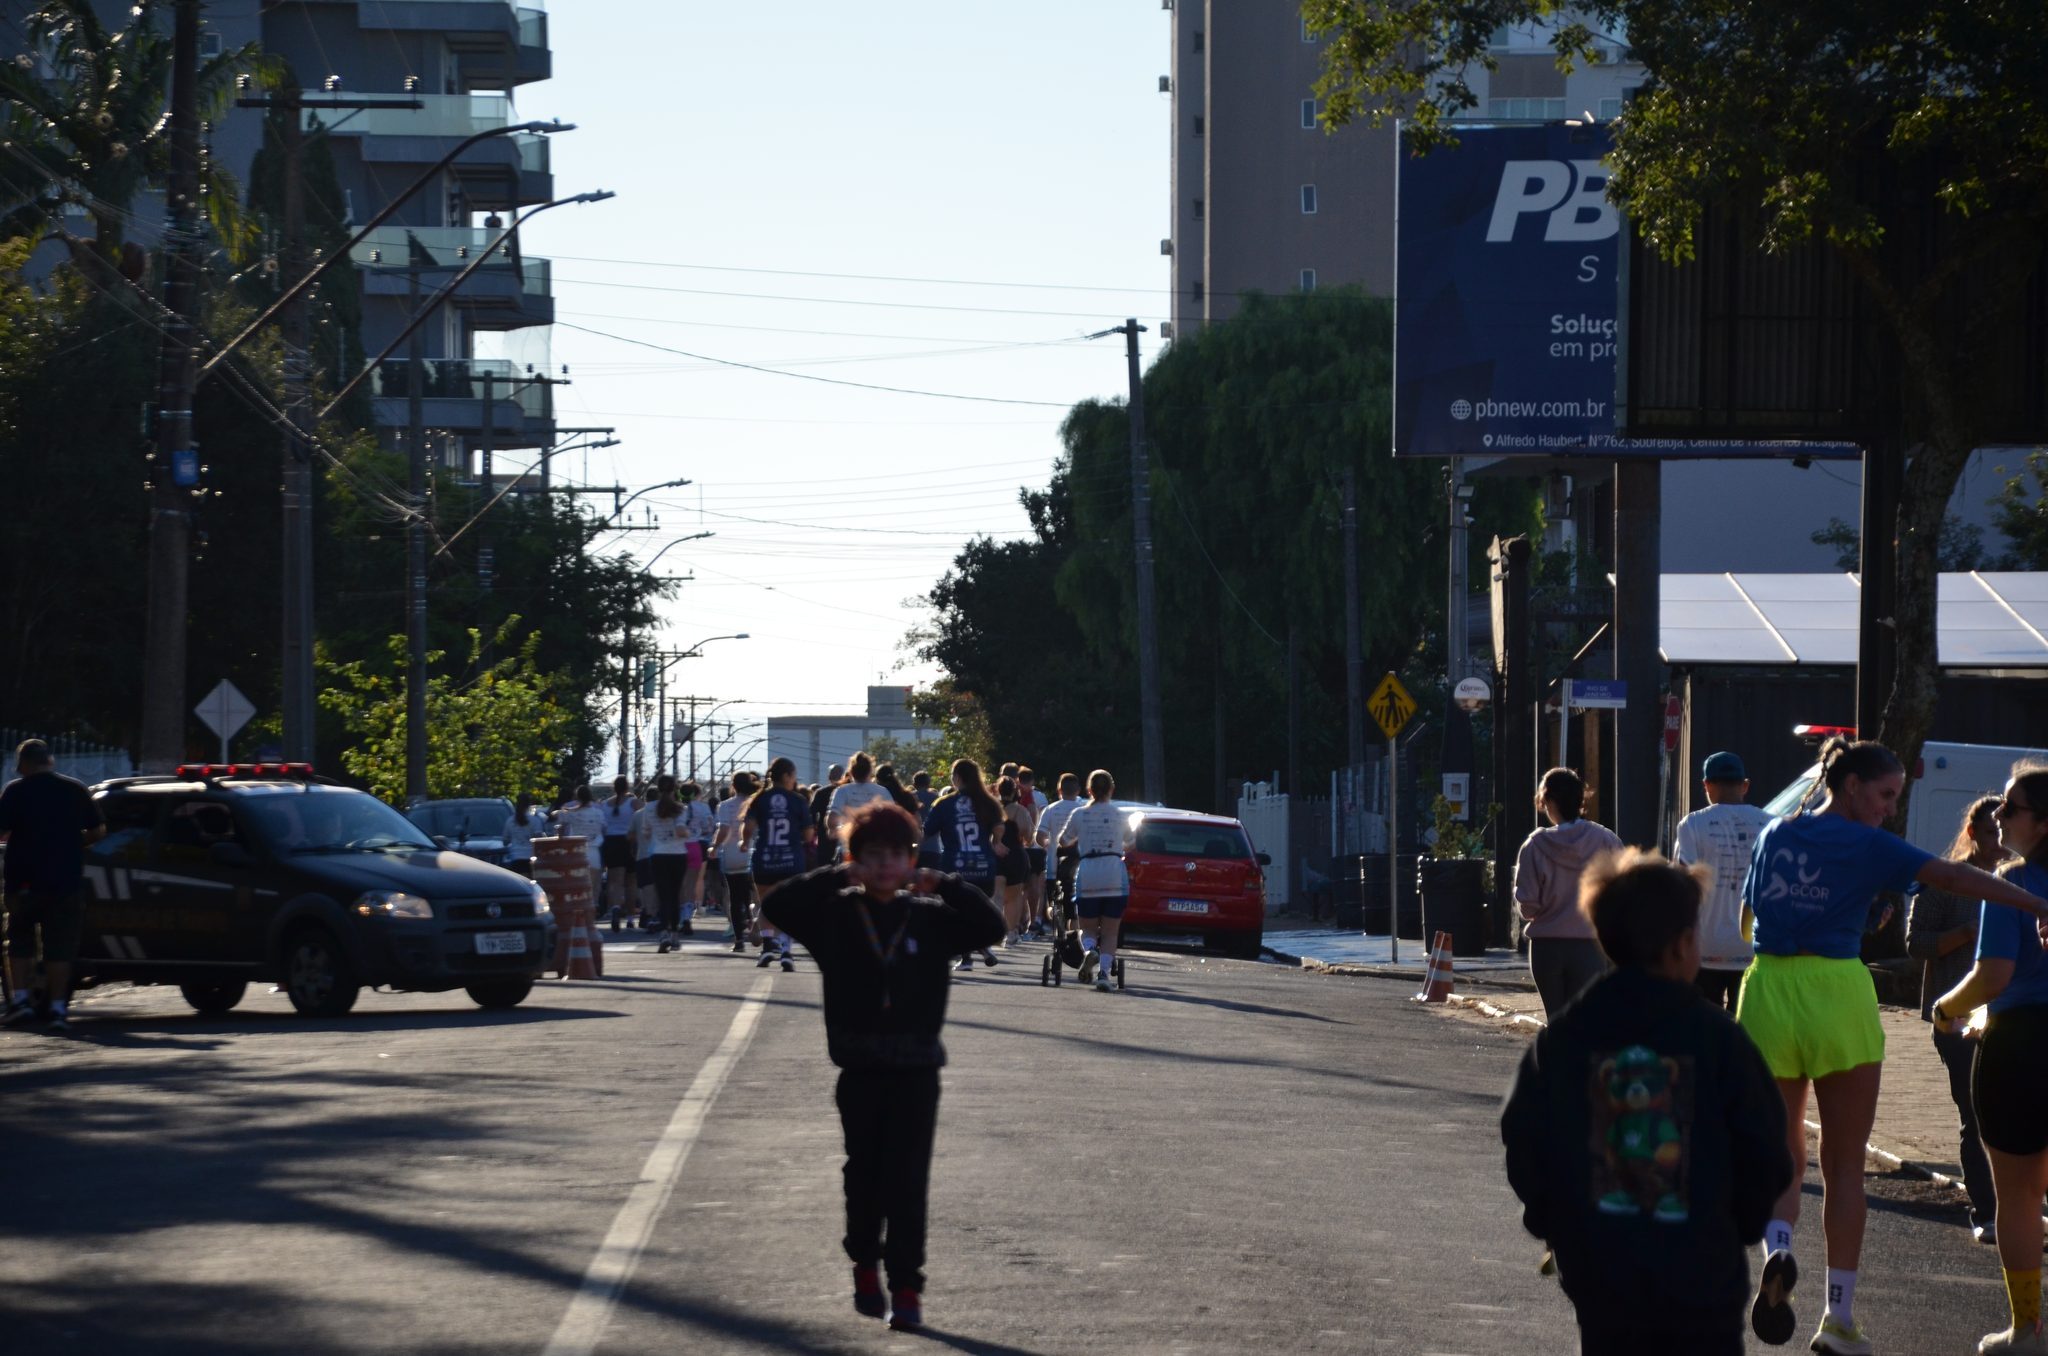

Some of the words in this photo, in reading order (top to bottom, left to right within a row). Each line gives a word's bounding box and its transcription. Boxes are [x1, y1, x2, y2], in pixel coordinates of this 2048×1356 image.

[1549, 341, 1584, 357] em
[1475, 398, 1606, 421] pbnew.com.br
[1496, 434, 1536, 447] Alfredo
[1666, 715, 1680, 730] PARE
[767, 818, 791, 846] 12
[955, 822, 982, 852] 12
